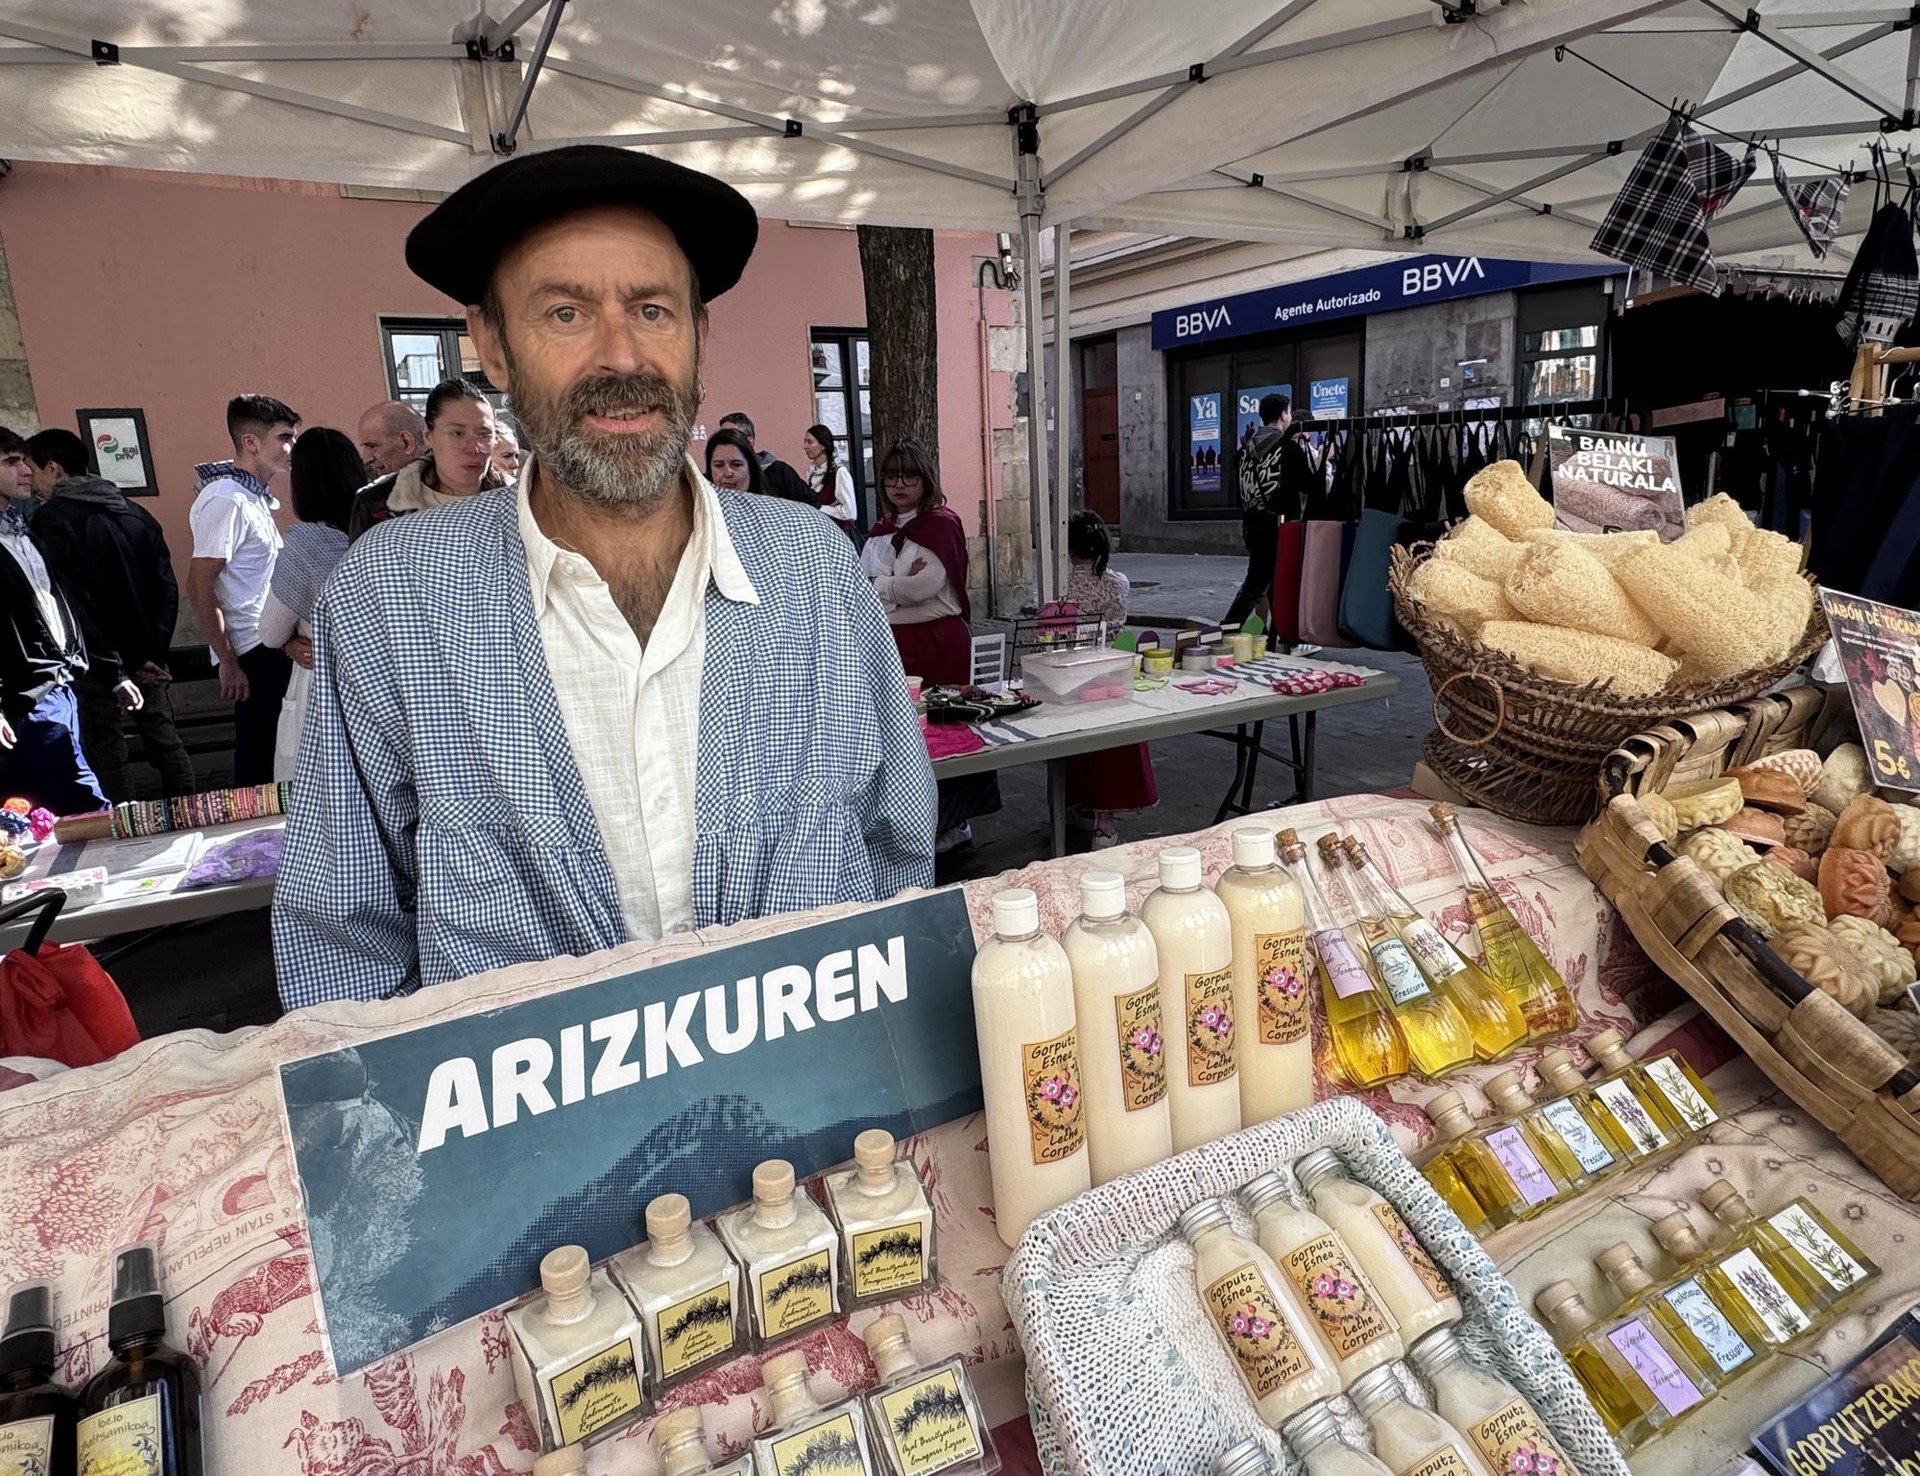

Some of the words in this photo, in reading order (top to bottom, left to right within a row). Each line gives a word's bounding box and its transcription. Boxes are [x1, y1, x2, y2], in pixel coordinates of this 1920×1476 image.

[1402, 256, 1485, 296] BBVA
[1274, 301, 1313, 321] Agente
[1316, 288, 1381, 311] Autorizado
[1176, 305, 1232, 338] BBVA
[1312, 382, 1346, 399] Únete
[1192, 396, 1218, 420] Ya
[1239, 394, 1260, 415] Sa
[1579, 435, 1647, 457] BAINU
[1577, 450, 1653, 474] BELAKI
[1558, 463, 1677, 493] NATURALA
[1828, 600, 1864, 622] JABÓN
[1873, 739, 1911, 780] 5€
[1262, 934, 1303, 951] Gorputz
[1272, 946, 1300, 961] Esnea
[1203, 983, 1230, 999] Esnea
[1394, 982, 1426, 999] Frescura
[1275, 1013, 1302, 1030] Leche
[417, 934, 909, 1153] ARIZKUREN
[1581, 1149, 1608, 1166] Frescura
[234, 1212, 276, 1239] STAIN
[1291, 1238, 1335, 1268] Gorputz
[1303, 1250, 1334, 1273] Esnea
[1210, 1272, 1256, 1303] Gorputz
[1220, 1284, 1252, 1309] Esnea
[53, 1296, 110, 1332] PRINTED
[1342, 1314, 1374, 1338] Leche
[1342, 1320, 1385, 1351] Corporal
[1716, 1341, 1746, 1363] Frescura
[1481, 1405, 1526, 1440] Gorputz
[1495, 1418, 1528, 1446] Esnea
[1408, 1454, 1457, 1476] orputz
